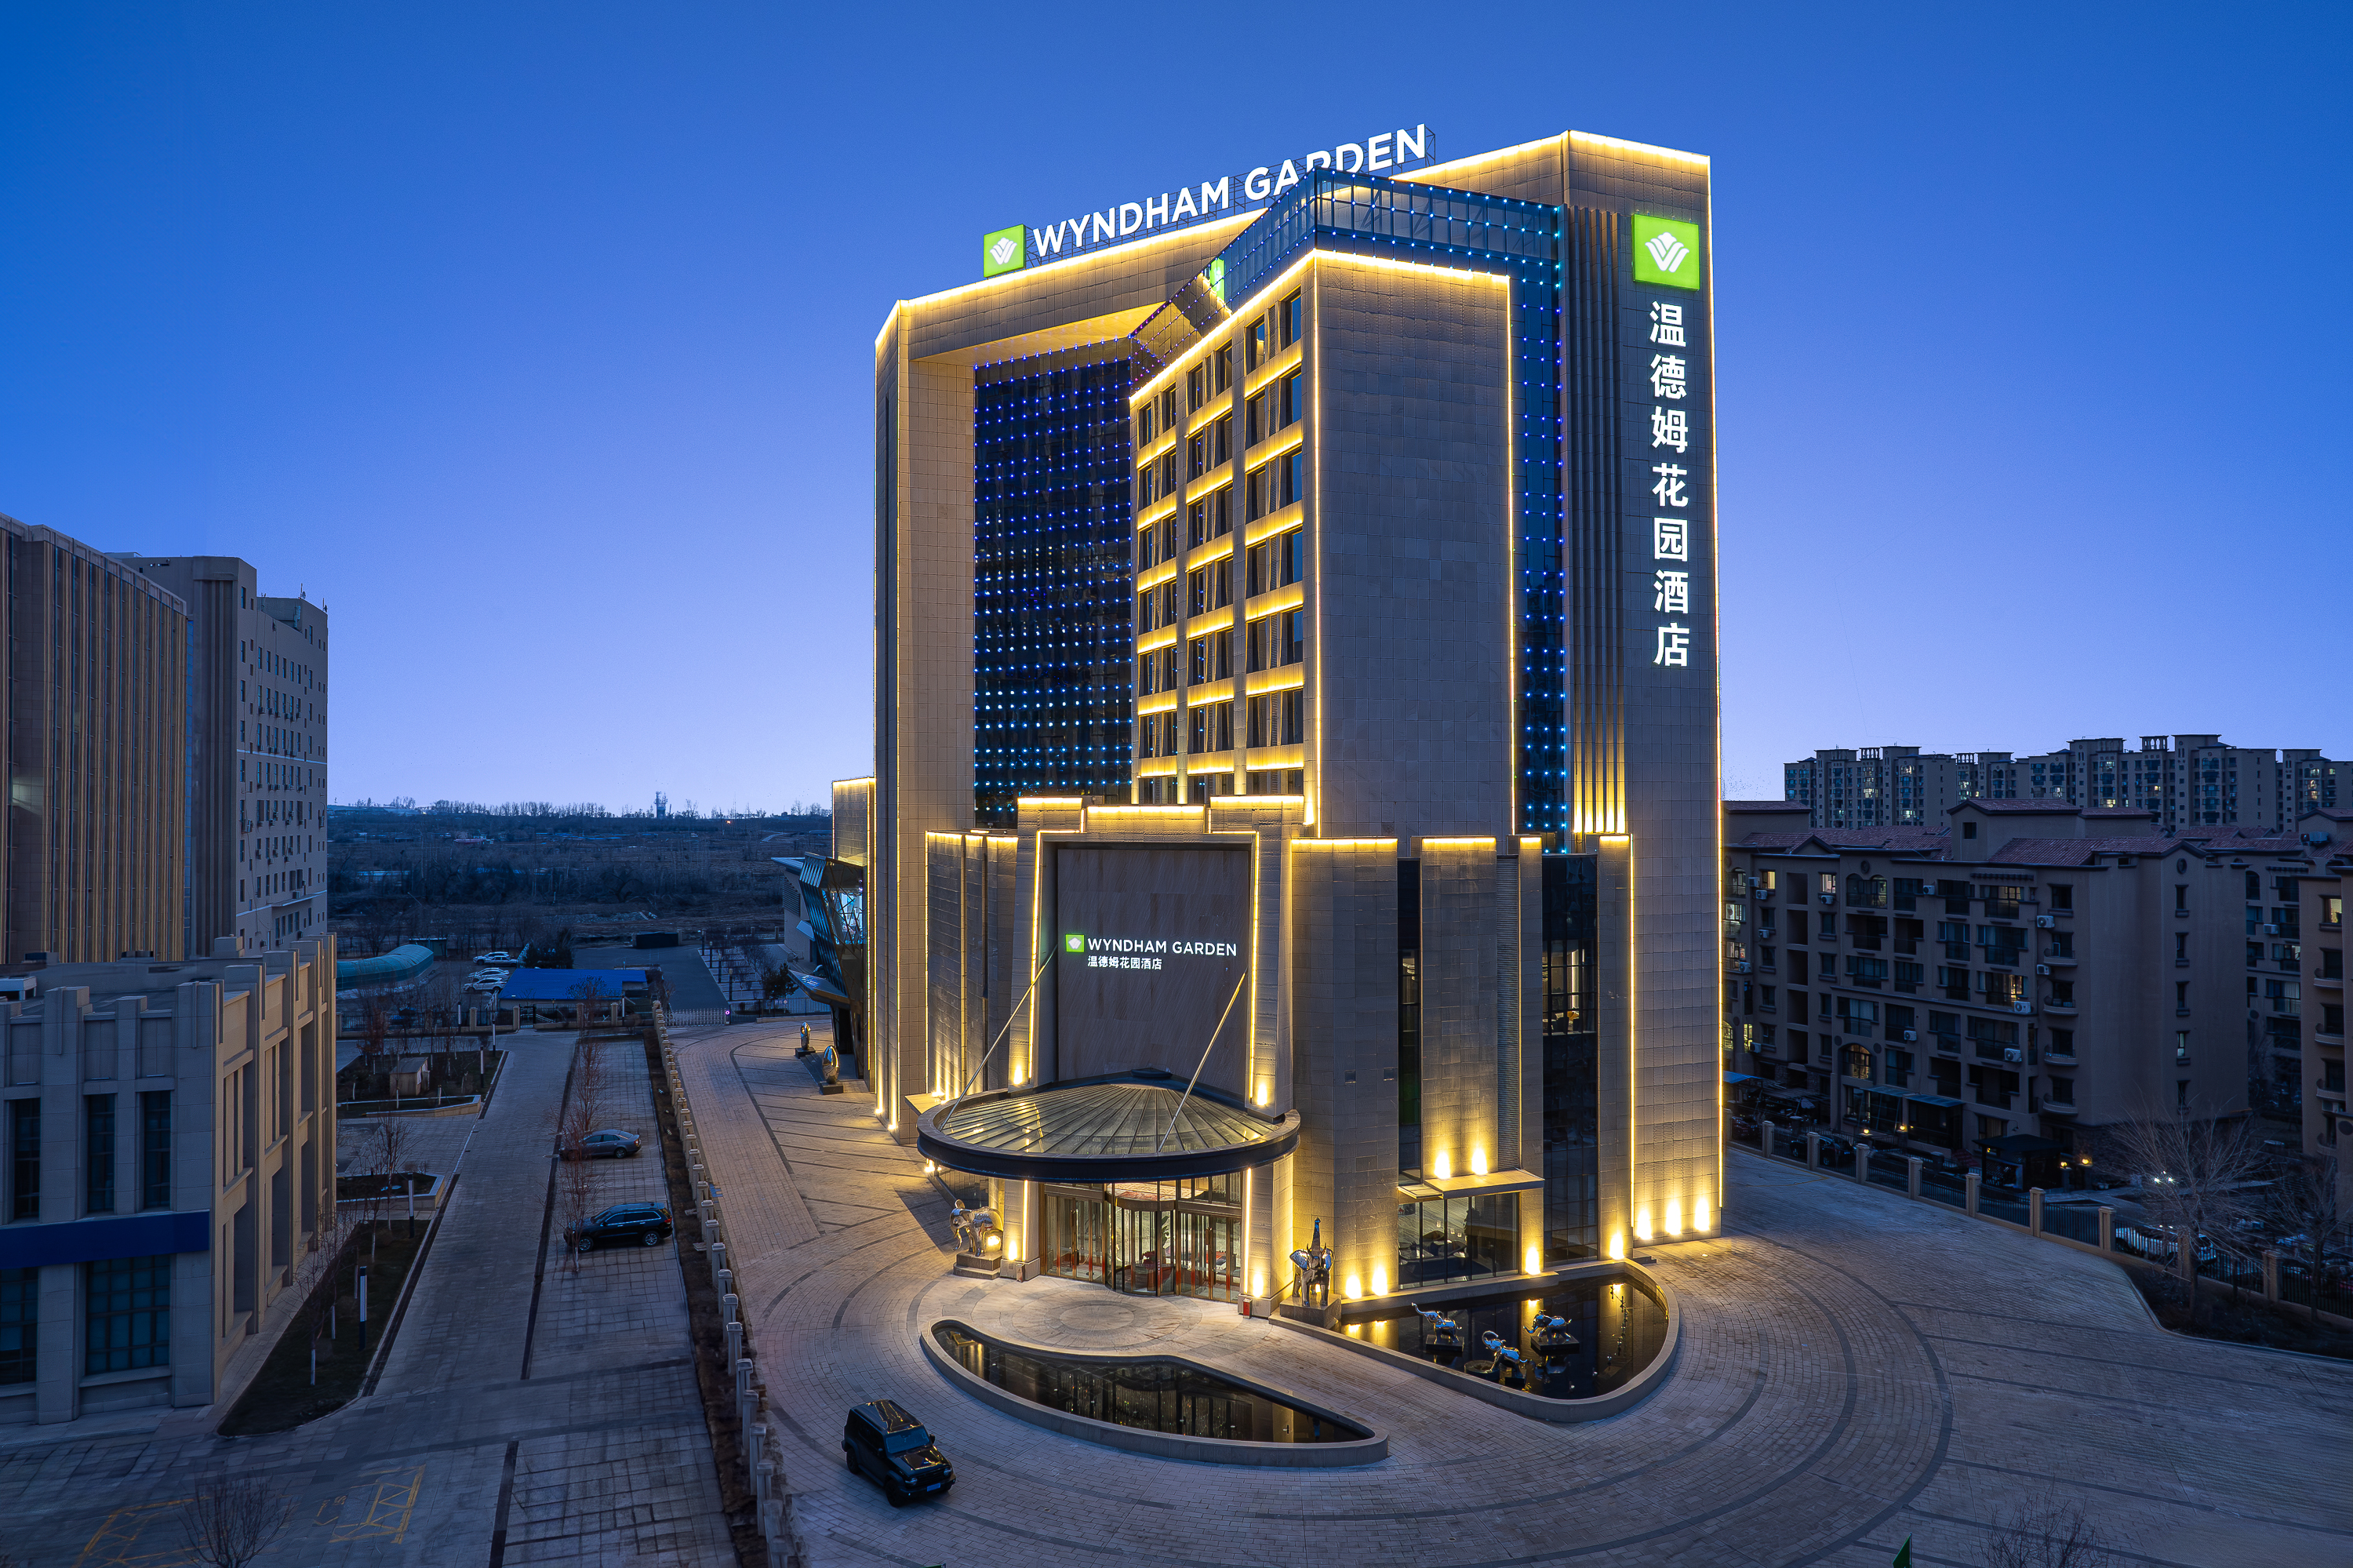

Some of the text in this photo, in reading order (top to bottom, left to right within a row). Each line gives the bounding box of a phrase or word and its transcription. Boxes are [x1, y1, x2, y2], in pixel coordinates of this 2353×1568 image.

[1032, 123, 1426, 257] WYNDHAM GARDEN
[1649, 300, 1690, 667] 温德姆花园酒店
[1087, 937, 1238, 956] WYNDHAM GARDEN
[1087, 955, 1162, 970] 温德姆花园酒店
